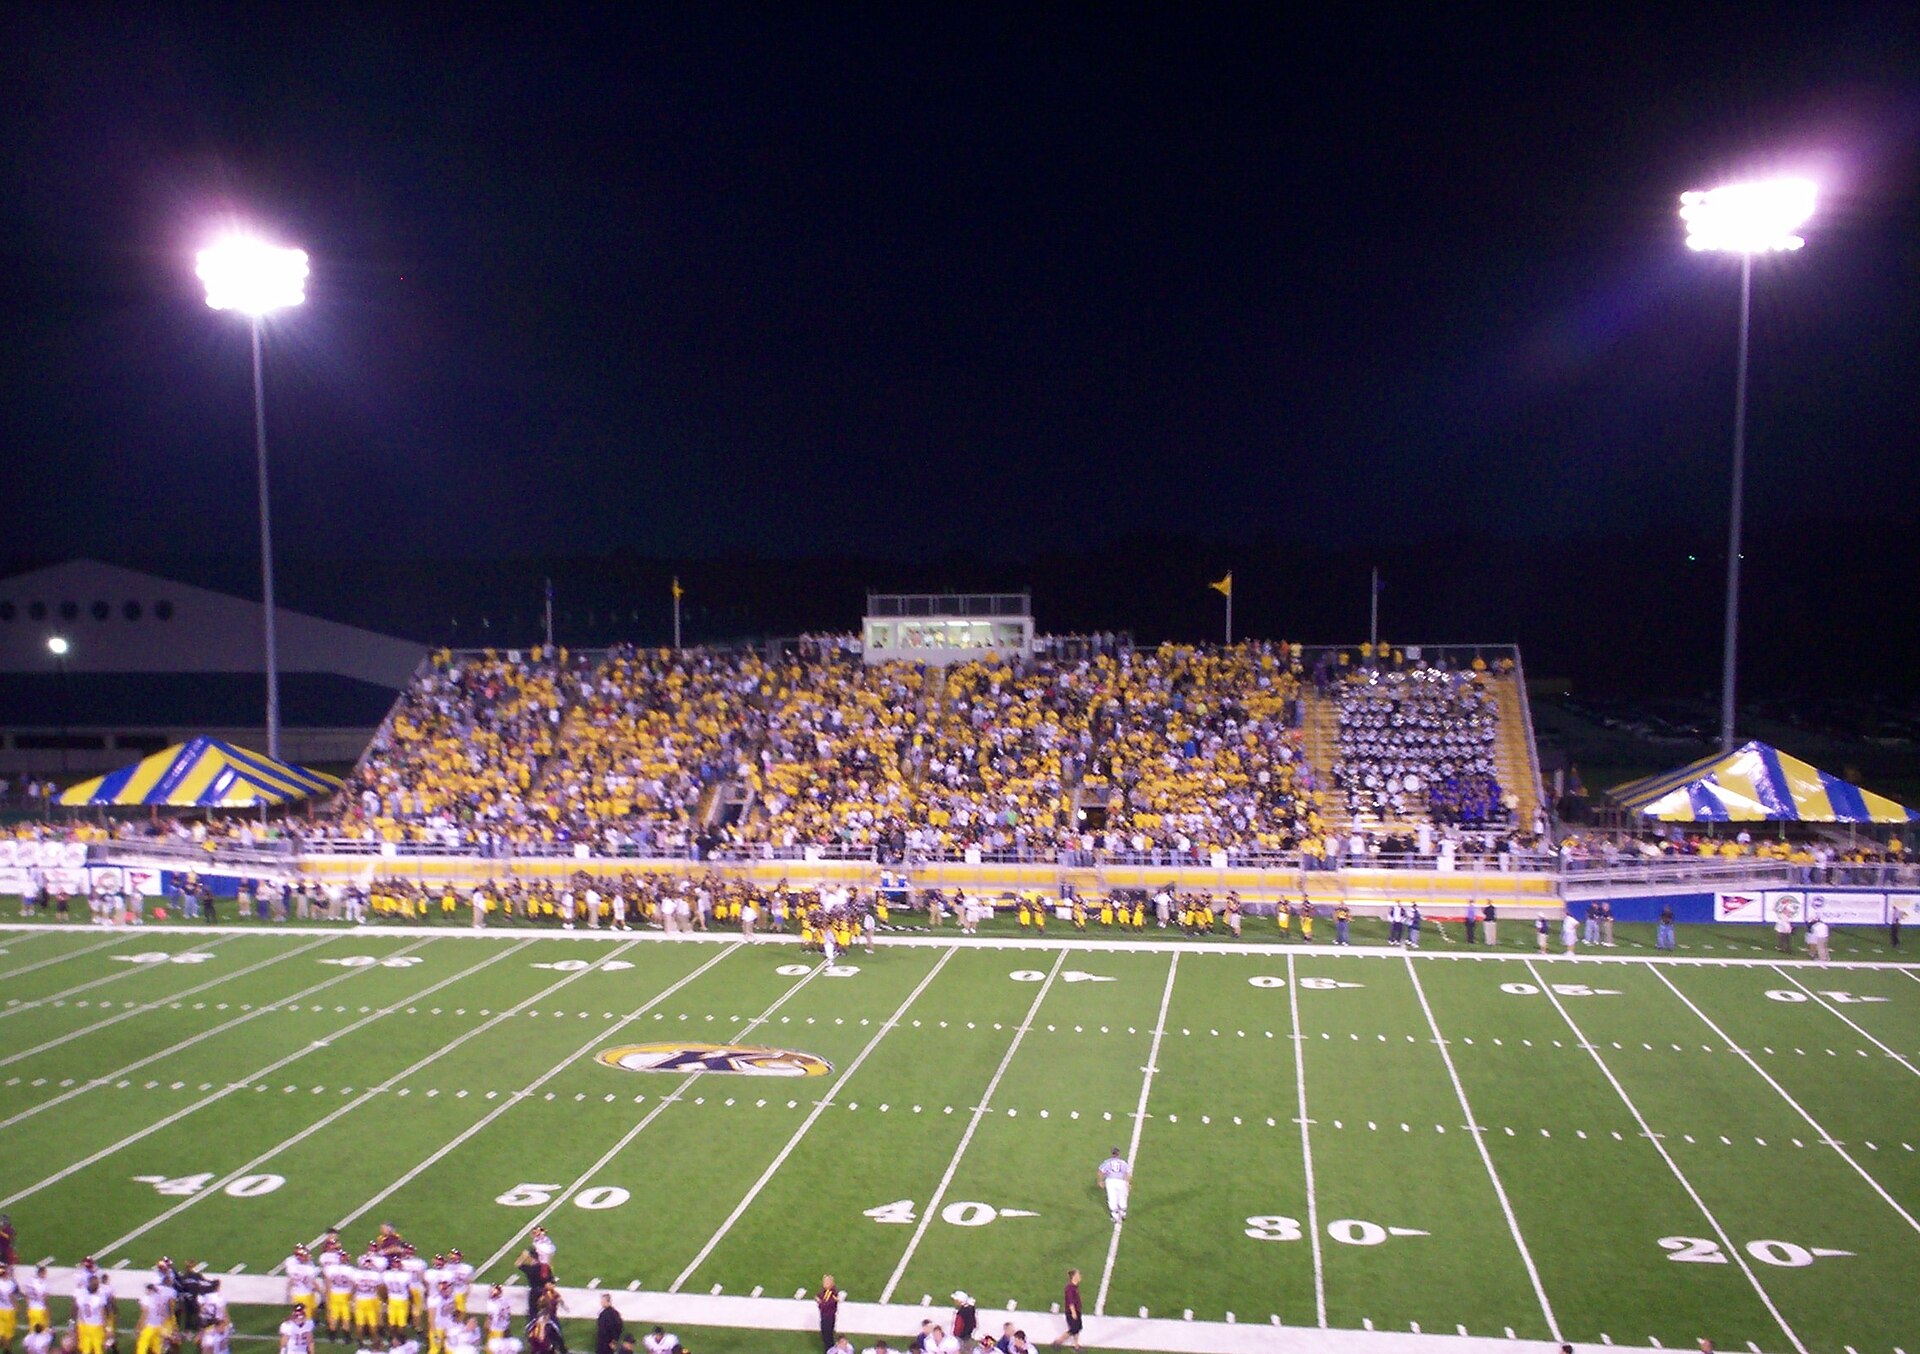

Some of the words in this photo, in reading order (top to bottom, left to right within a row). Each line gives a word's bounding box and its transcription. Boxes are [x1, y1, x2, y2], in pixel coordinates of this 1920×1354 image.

[1247, 975, 1338, 989] 30
[1500, 982, 1597, 997] 20
[1764, 988, 1861, 1003] 10
[153, 1172, 286, 1197] 40
[495, 1183, 631, 1210] 50
[863, 1199, 997, 1227] 40
[1244, 1215, 1387, 1246] 30
[1657, 1236, 1814, 1267] 20
